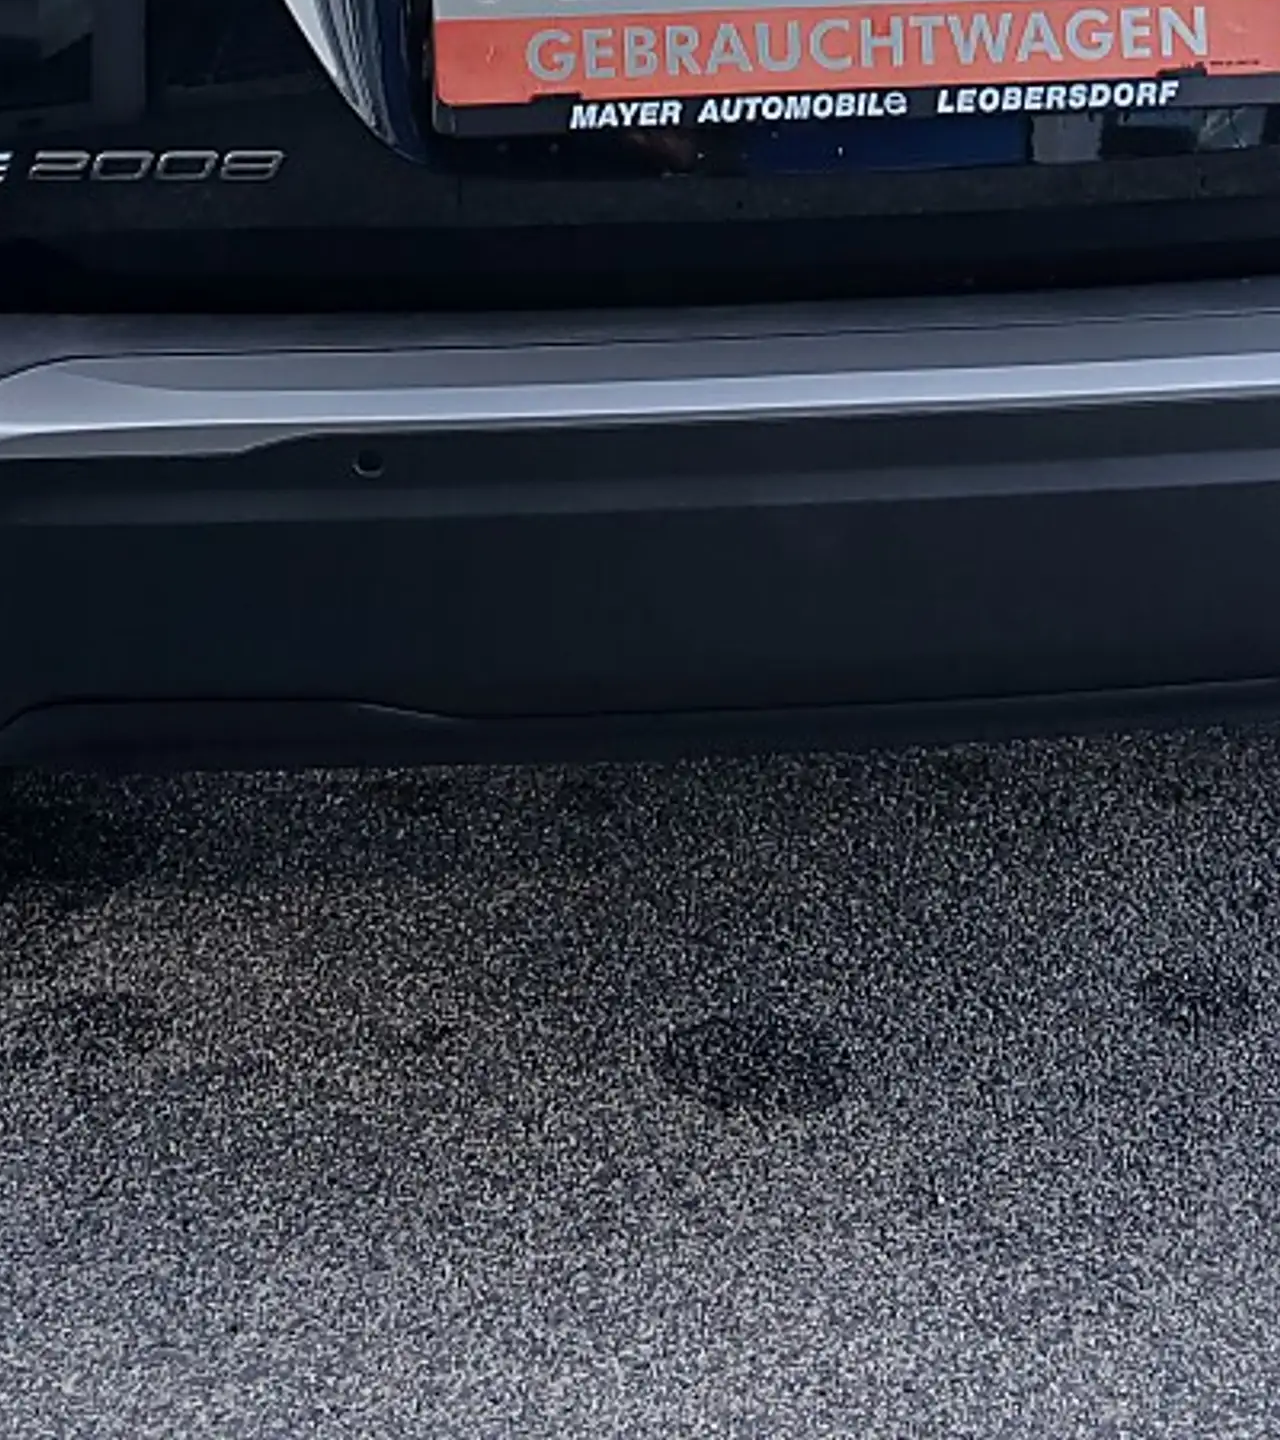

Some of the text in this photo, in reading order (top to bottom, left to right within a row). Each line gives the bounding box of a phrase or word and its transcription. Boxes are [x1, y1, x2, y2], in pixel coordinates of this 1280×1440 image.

[525, 5, 1209, 82] GEBRAUCHTWAGEN
[569, 101, 683, 130] MAYER
[936, 79, 1180, 114] LEOBERSDORF
[29, 149, 287, 182] 2008
